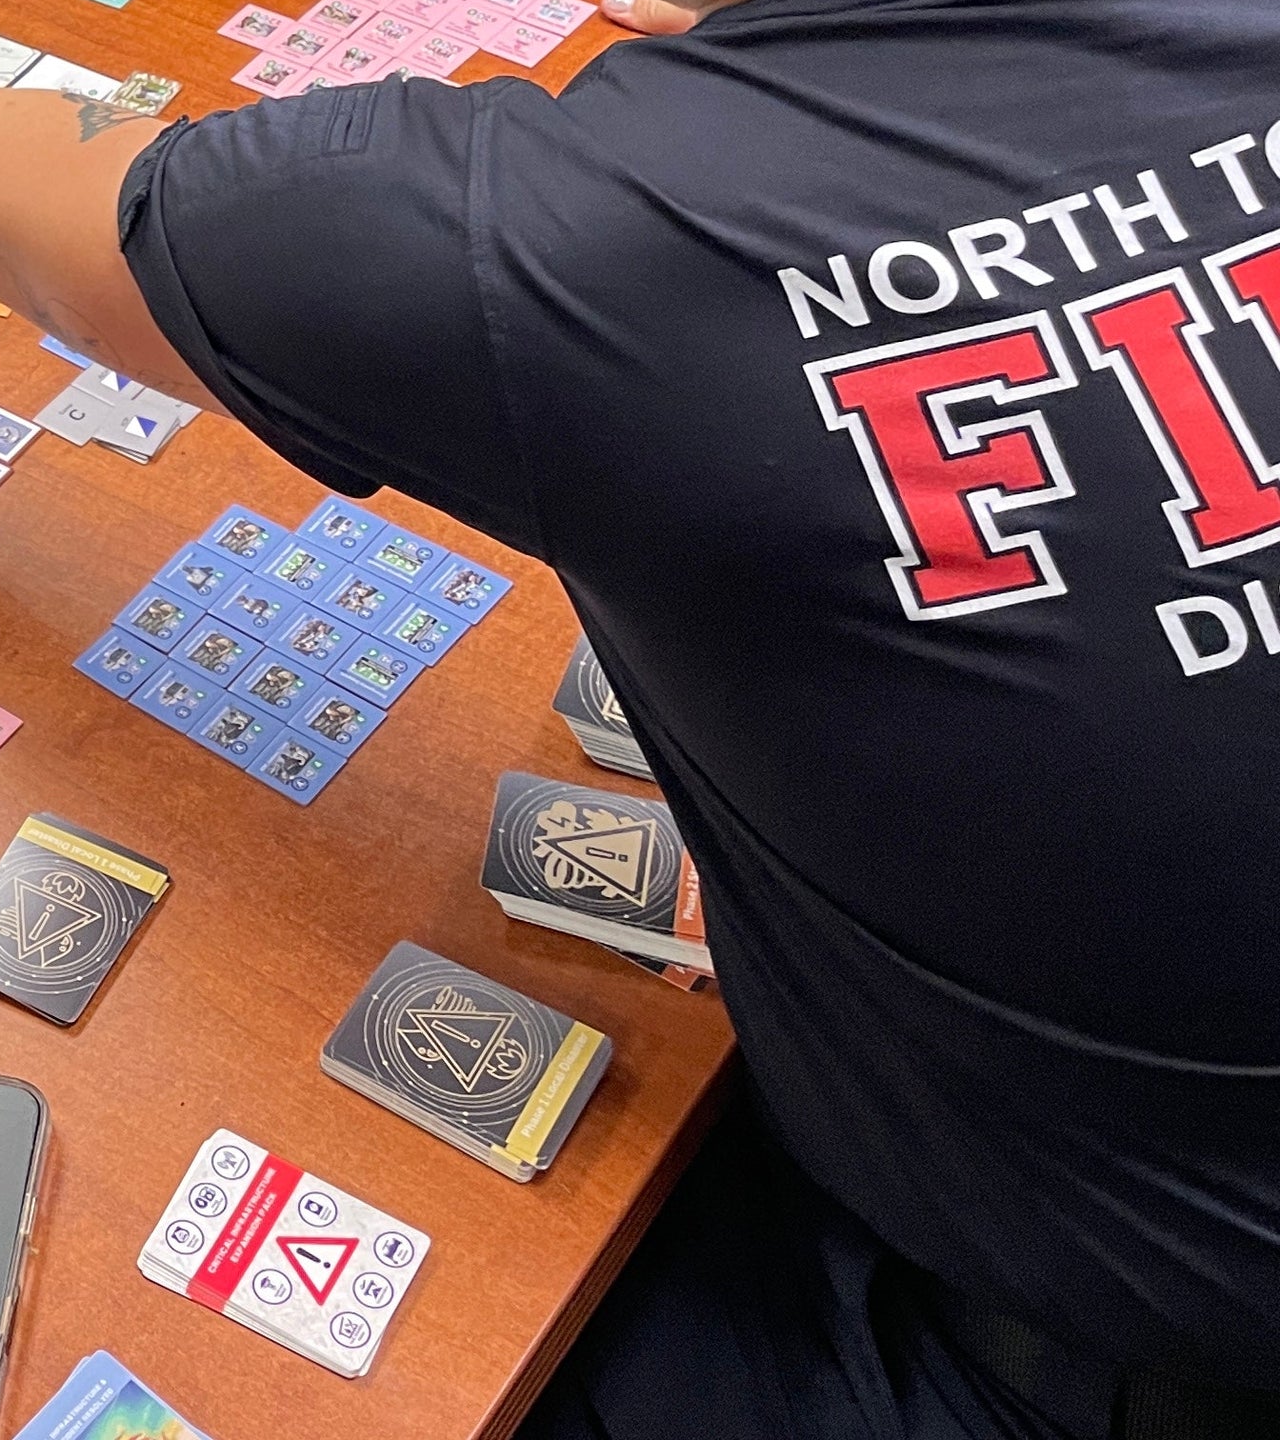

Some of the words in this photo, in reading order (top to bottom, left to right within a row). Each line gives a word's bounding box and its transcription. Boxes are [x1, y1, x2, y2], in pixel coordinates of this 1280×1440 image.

[776, 169, 1189, 339] NORTH
[1190, 119, 1280, 215] T
[1155, 580, 1280, 677] DI
[24, 824, 71, 854] Disaster
[70, 844, 103, 867] Local
[112, 862, 141, 883] Phase
[687, 880, 701, 890] 2
[686, 892, 701, 922] Phase
[520, 1105, 546, 1140] Phase
[542, 1069, 566, 1100] Local
[557, 1029, 590, 1074] Disaster
[205, 1235, 236, 1275] CRITICAL
[227, 1166, 279, 1238] INFRASTRUCTURE
[227, 1215, 264, 1265] EXPANSION
[255, 1190, 278, 1218] PACK
[48, 1384, 101, 1440] INFRASTRUCTURE
